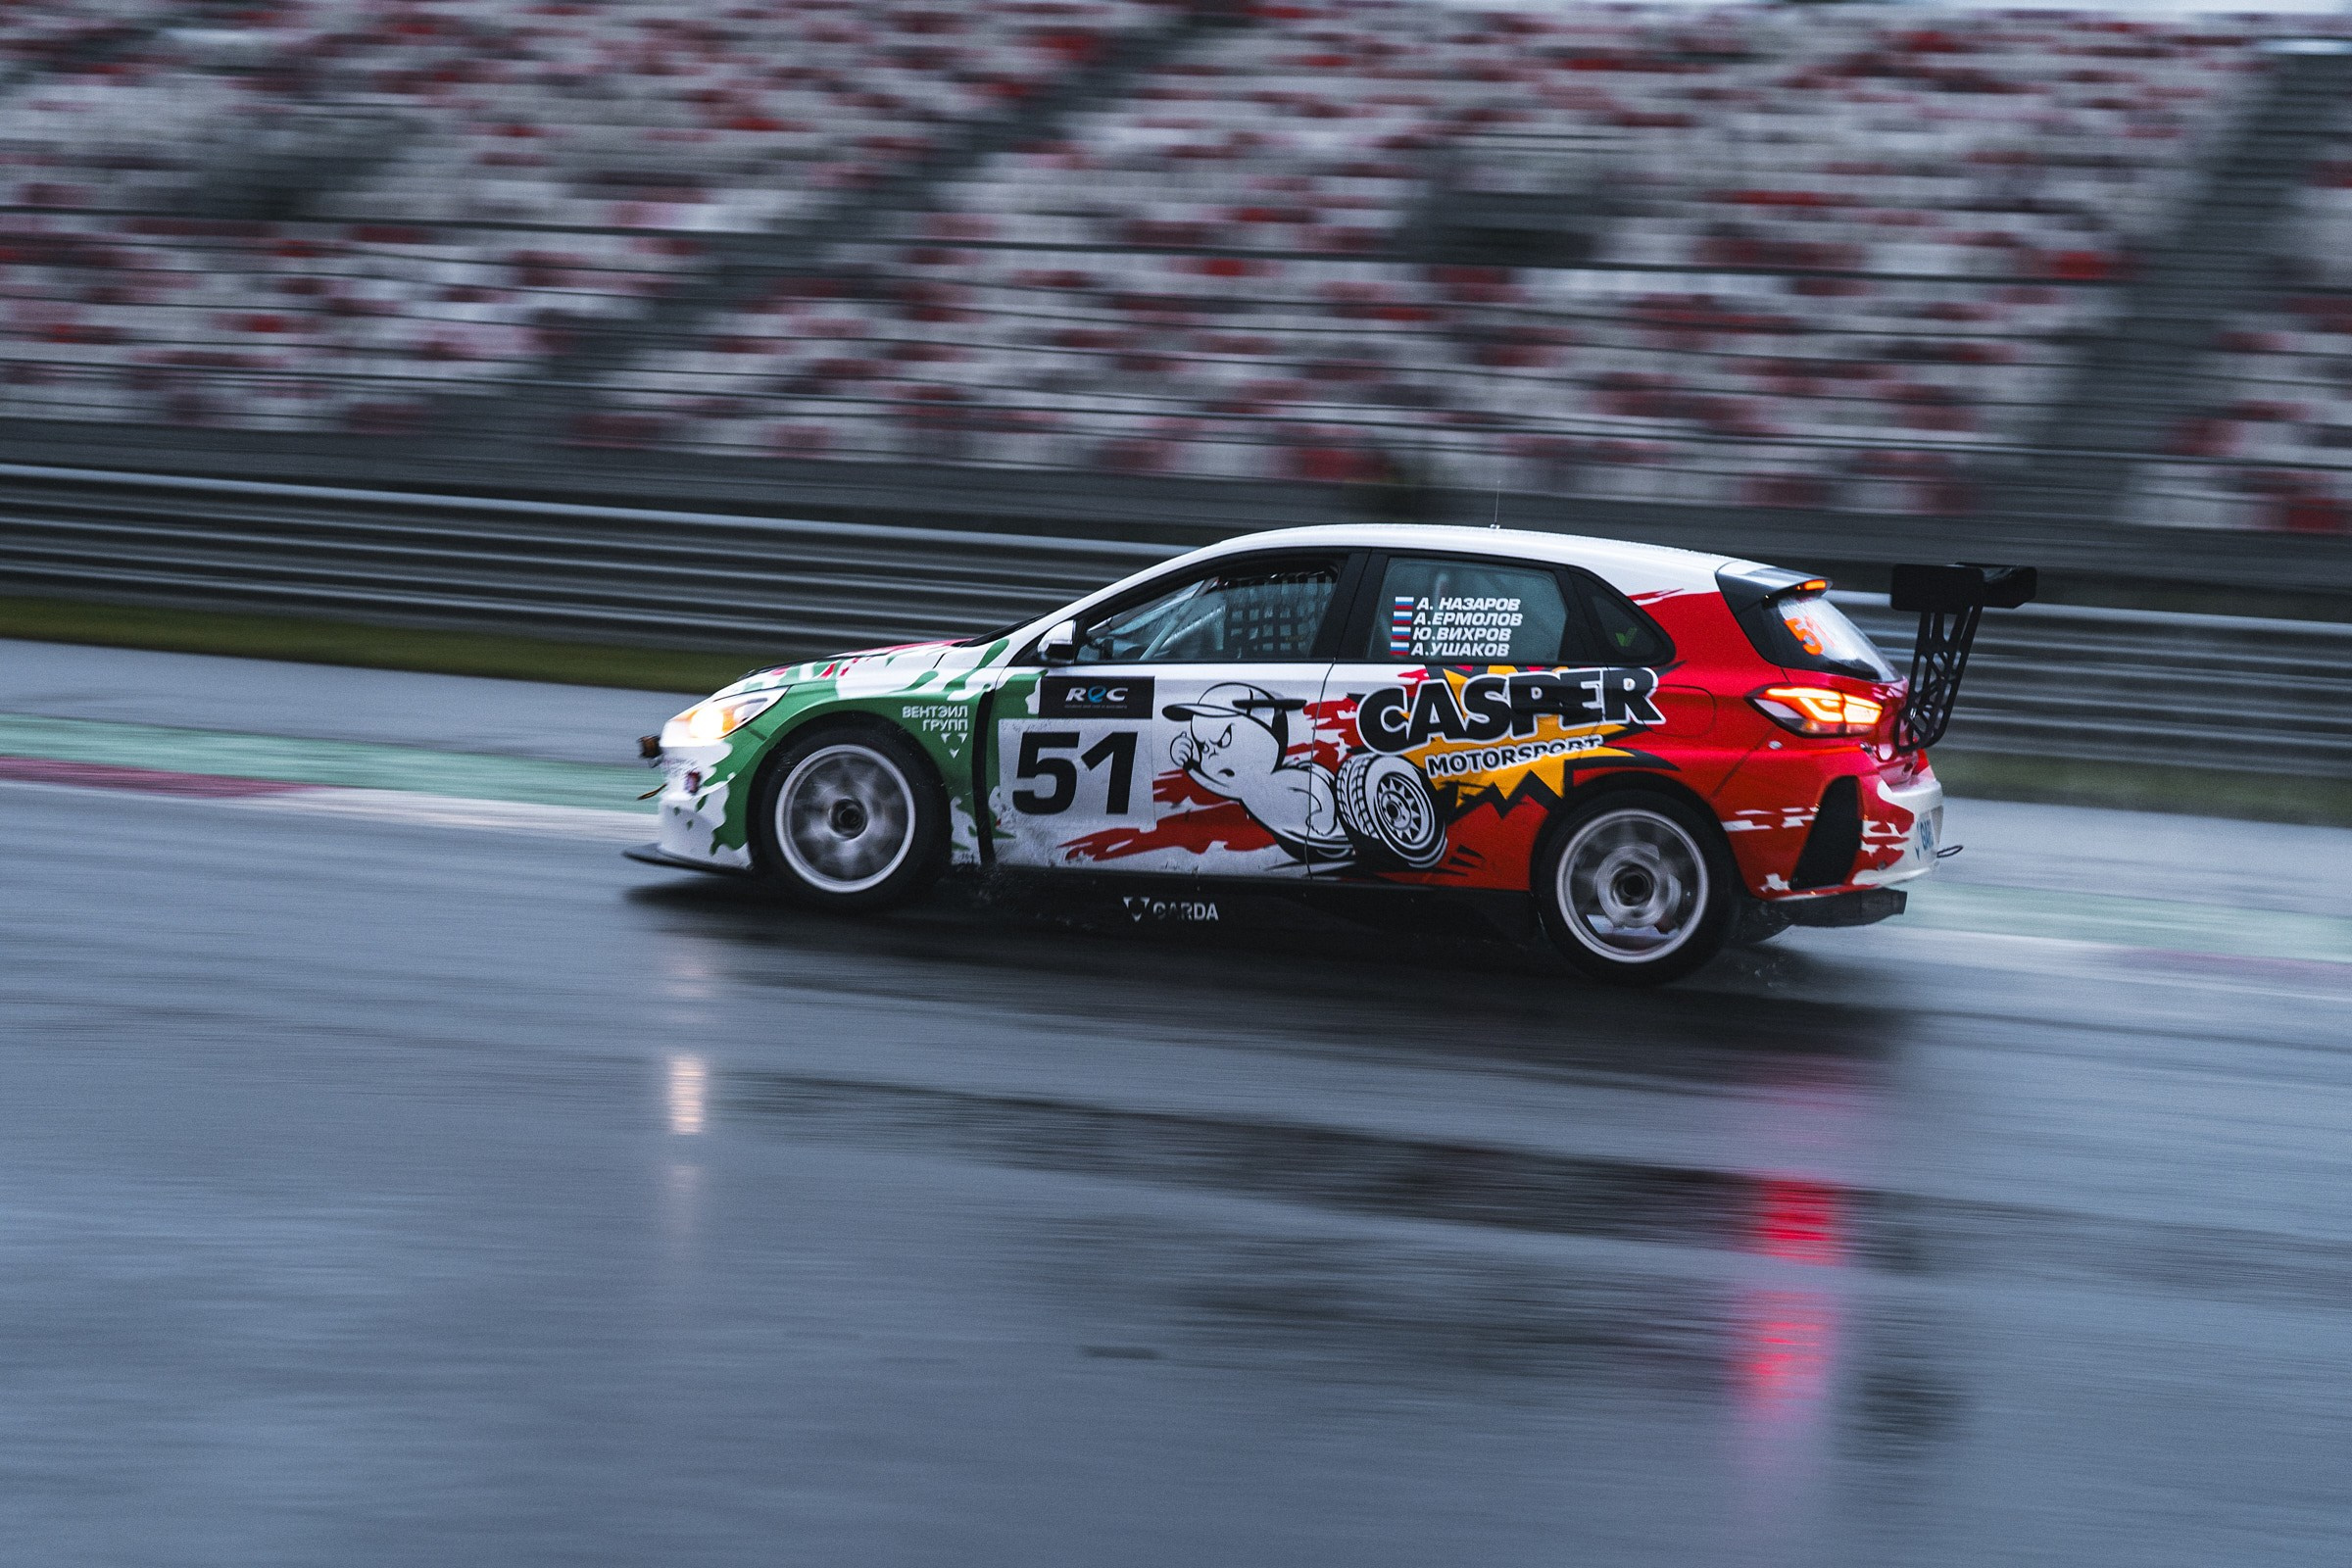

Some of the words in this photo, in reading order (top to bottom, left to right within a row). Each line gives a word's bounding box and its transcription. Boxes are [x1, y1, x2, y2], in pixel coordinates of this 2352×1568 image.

[1416, 596, 1434, 612] А.
[1439, 596, 1521, 612] НАЗАРОВ
[1412, 612, 1524, 626] А.ЕРМОЛОВ
[1411, 626, 1512, 642] Ю.ВИХРОВ
[1410, 642, 1510, 657] А.УШАКОВ
[902, 705, 968, 718] ВЕНТЭИЛ
[1356, 667, 1666, 755] CASPER
[922, 718, 968, 732] ГРУПП
[1426, 734, 1604, 778] MOTORSPORT
[1012, 730, 1139, 816] 51
